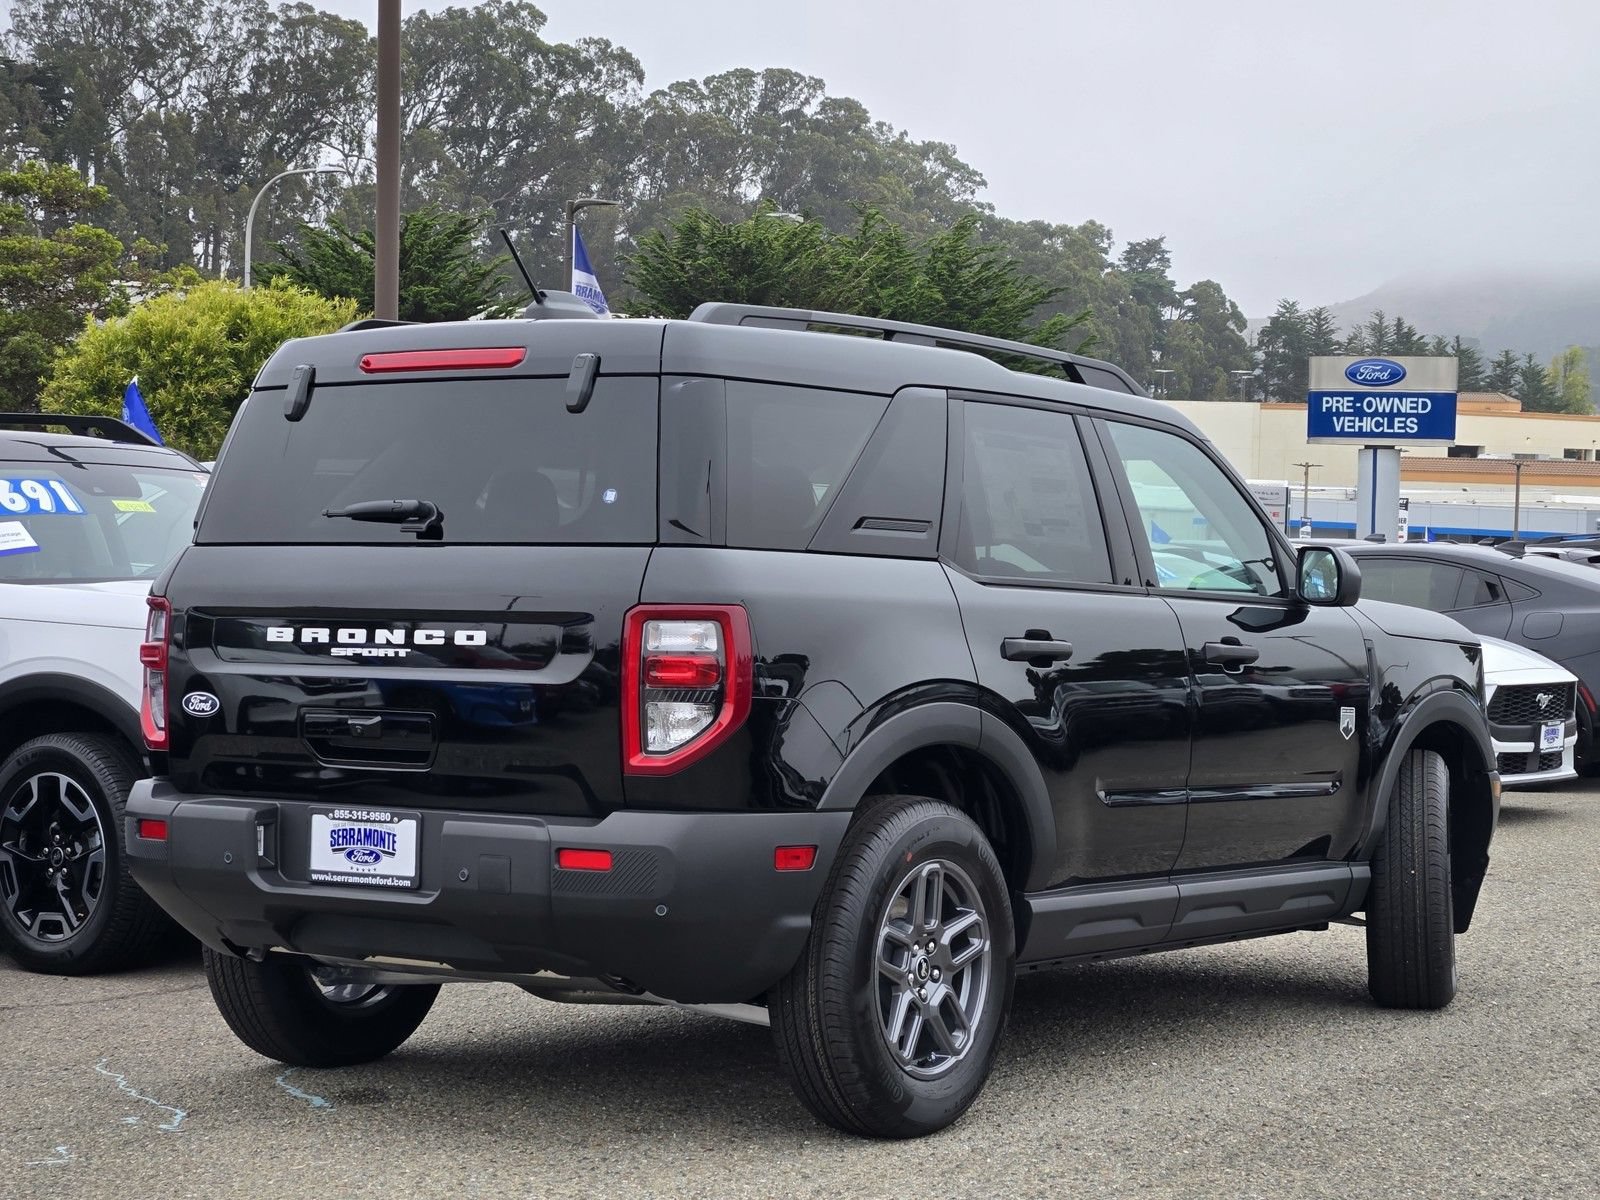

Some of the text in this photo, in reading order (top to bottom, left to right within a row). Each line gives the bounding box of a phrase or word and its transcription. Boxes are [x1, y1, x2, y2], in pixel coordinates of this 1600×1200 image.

[1356, 365, 1391, 380] Ford
[1333, 417, 1418, 433] VEHICLES
[266, 627, 487, 646] BRONCO
[330, 647, 412, 657] SPORT
[187, 696, 213, 712] Ford
[334, 809, 391, 821] 855-315-9580
[330, 827, 397, 852] SERRAMONTE
[350, 850, 376, 863] Ford
[311, 872, 411, 887] www.serramonteford.com
